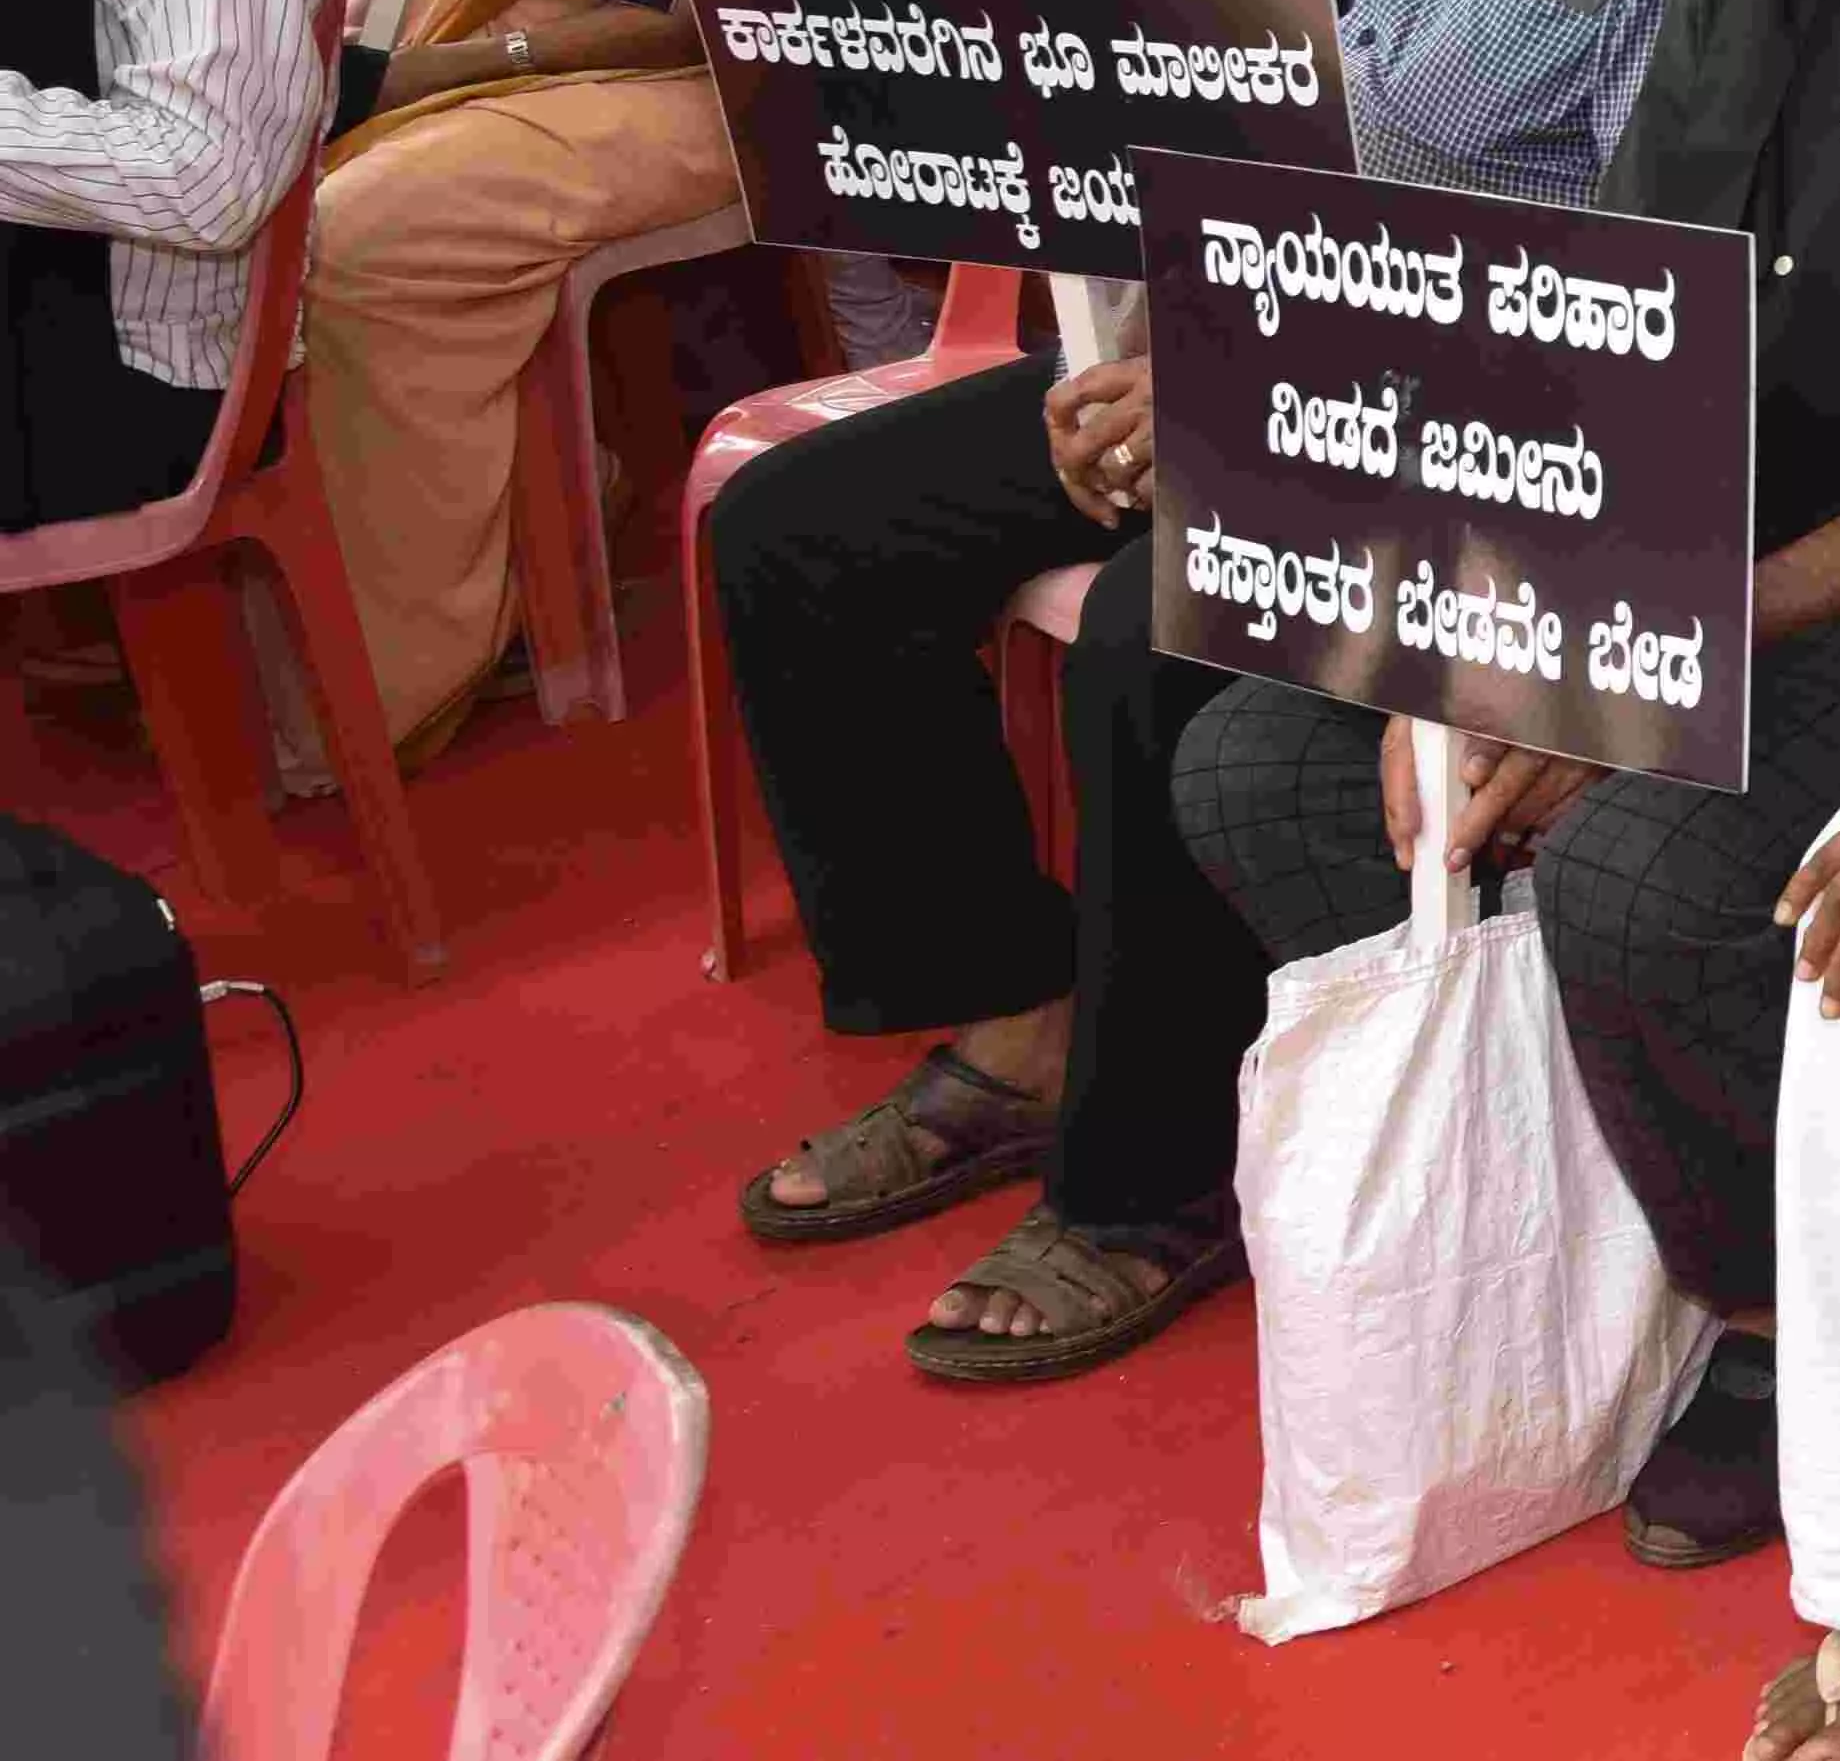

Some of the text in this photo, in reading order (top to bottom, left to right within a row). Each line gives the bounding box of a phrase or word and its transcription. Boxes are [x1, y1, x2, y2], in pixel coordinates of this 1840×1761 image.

[1019, 14, 1095, 99] ಭೂ
[1110, 21, 1319, 107] ಮಾಲೀಕರ
[818, 125, 1040, 250] ಹೋರಾಟಕ್ಕೆ
[1201, 212, 1676, 362] ನ್ಯಾಯಯುತ ಪರಿಹಾರ
[1267, 381, 1604, 521] ನೀಡದೆ ಜಮೀನು
[1186, 510, 1703, 710] ಹಸ್ತಾಂತರ ಬೇಡವೇ ಬೇಡ
